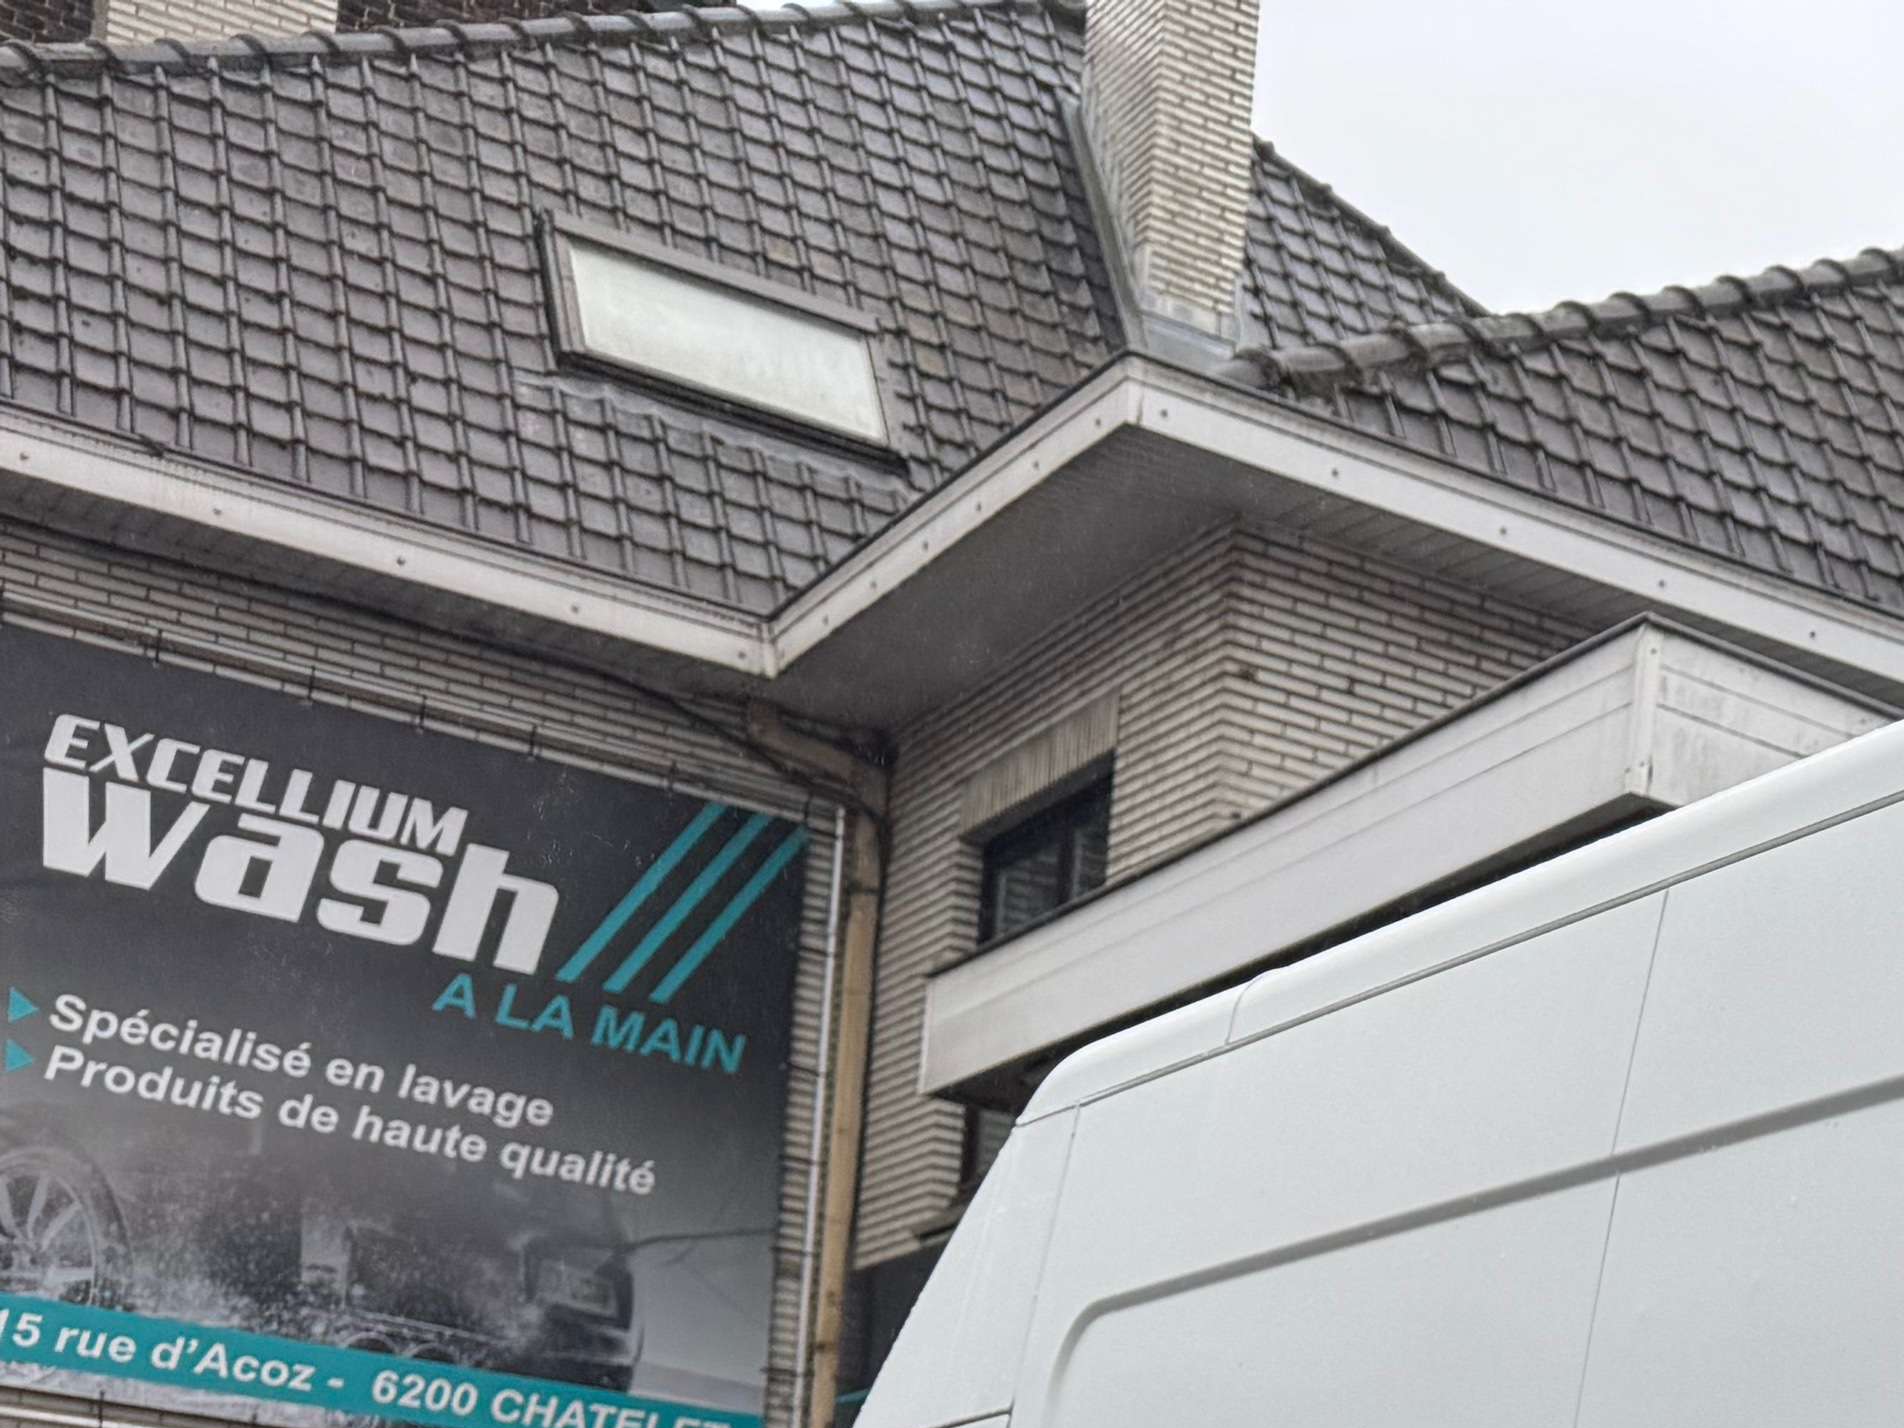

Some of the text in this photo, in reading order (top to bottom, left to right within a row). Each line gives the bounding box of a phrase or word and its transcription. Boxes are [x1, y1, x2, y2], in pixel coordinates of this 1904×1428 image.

[43, 713, 469, 858] EXCELLIUM
[50, 993, 554, 1131] Spécialisé en lavage
[433, 973, 747, 1074] A LA MAIN
[44, 1046, 656, 1196] Produits de haute qualité
[54, 1327, 137, 1363] rue
[371, 1369, 480, 1419] 6200
